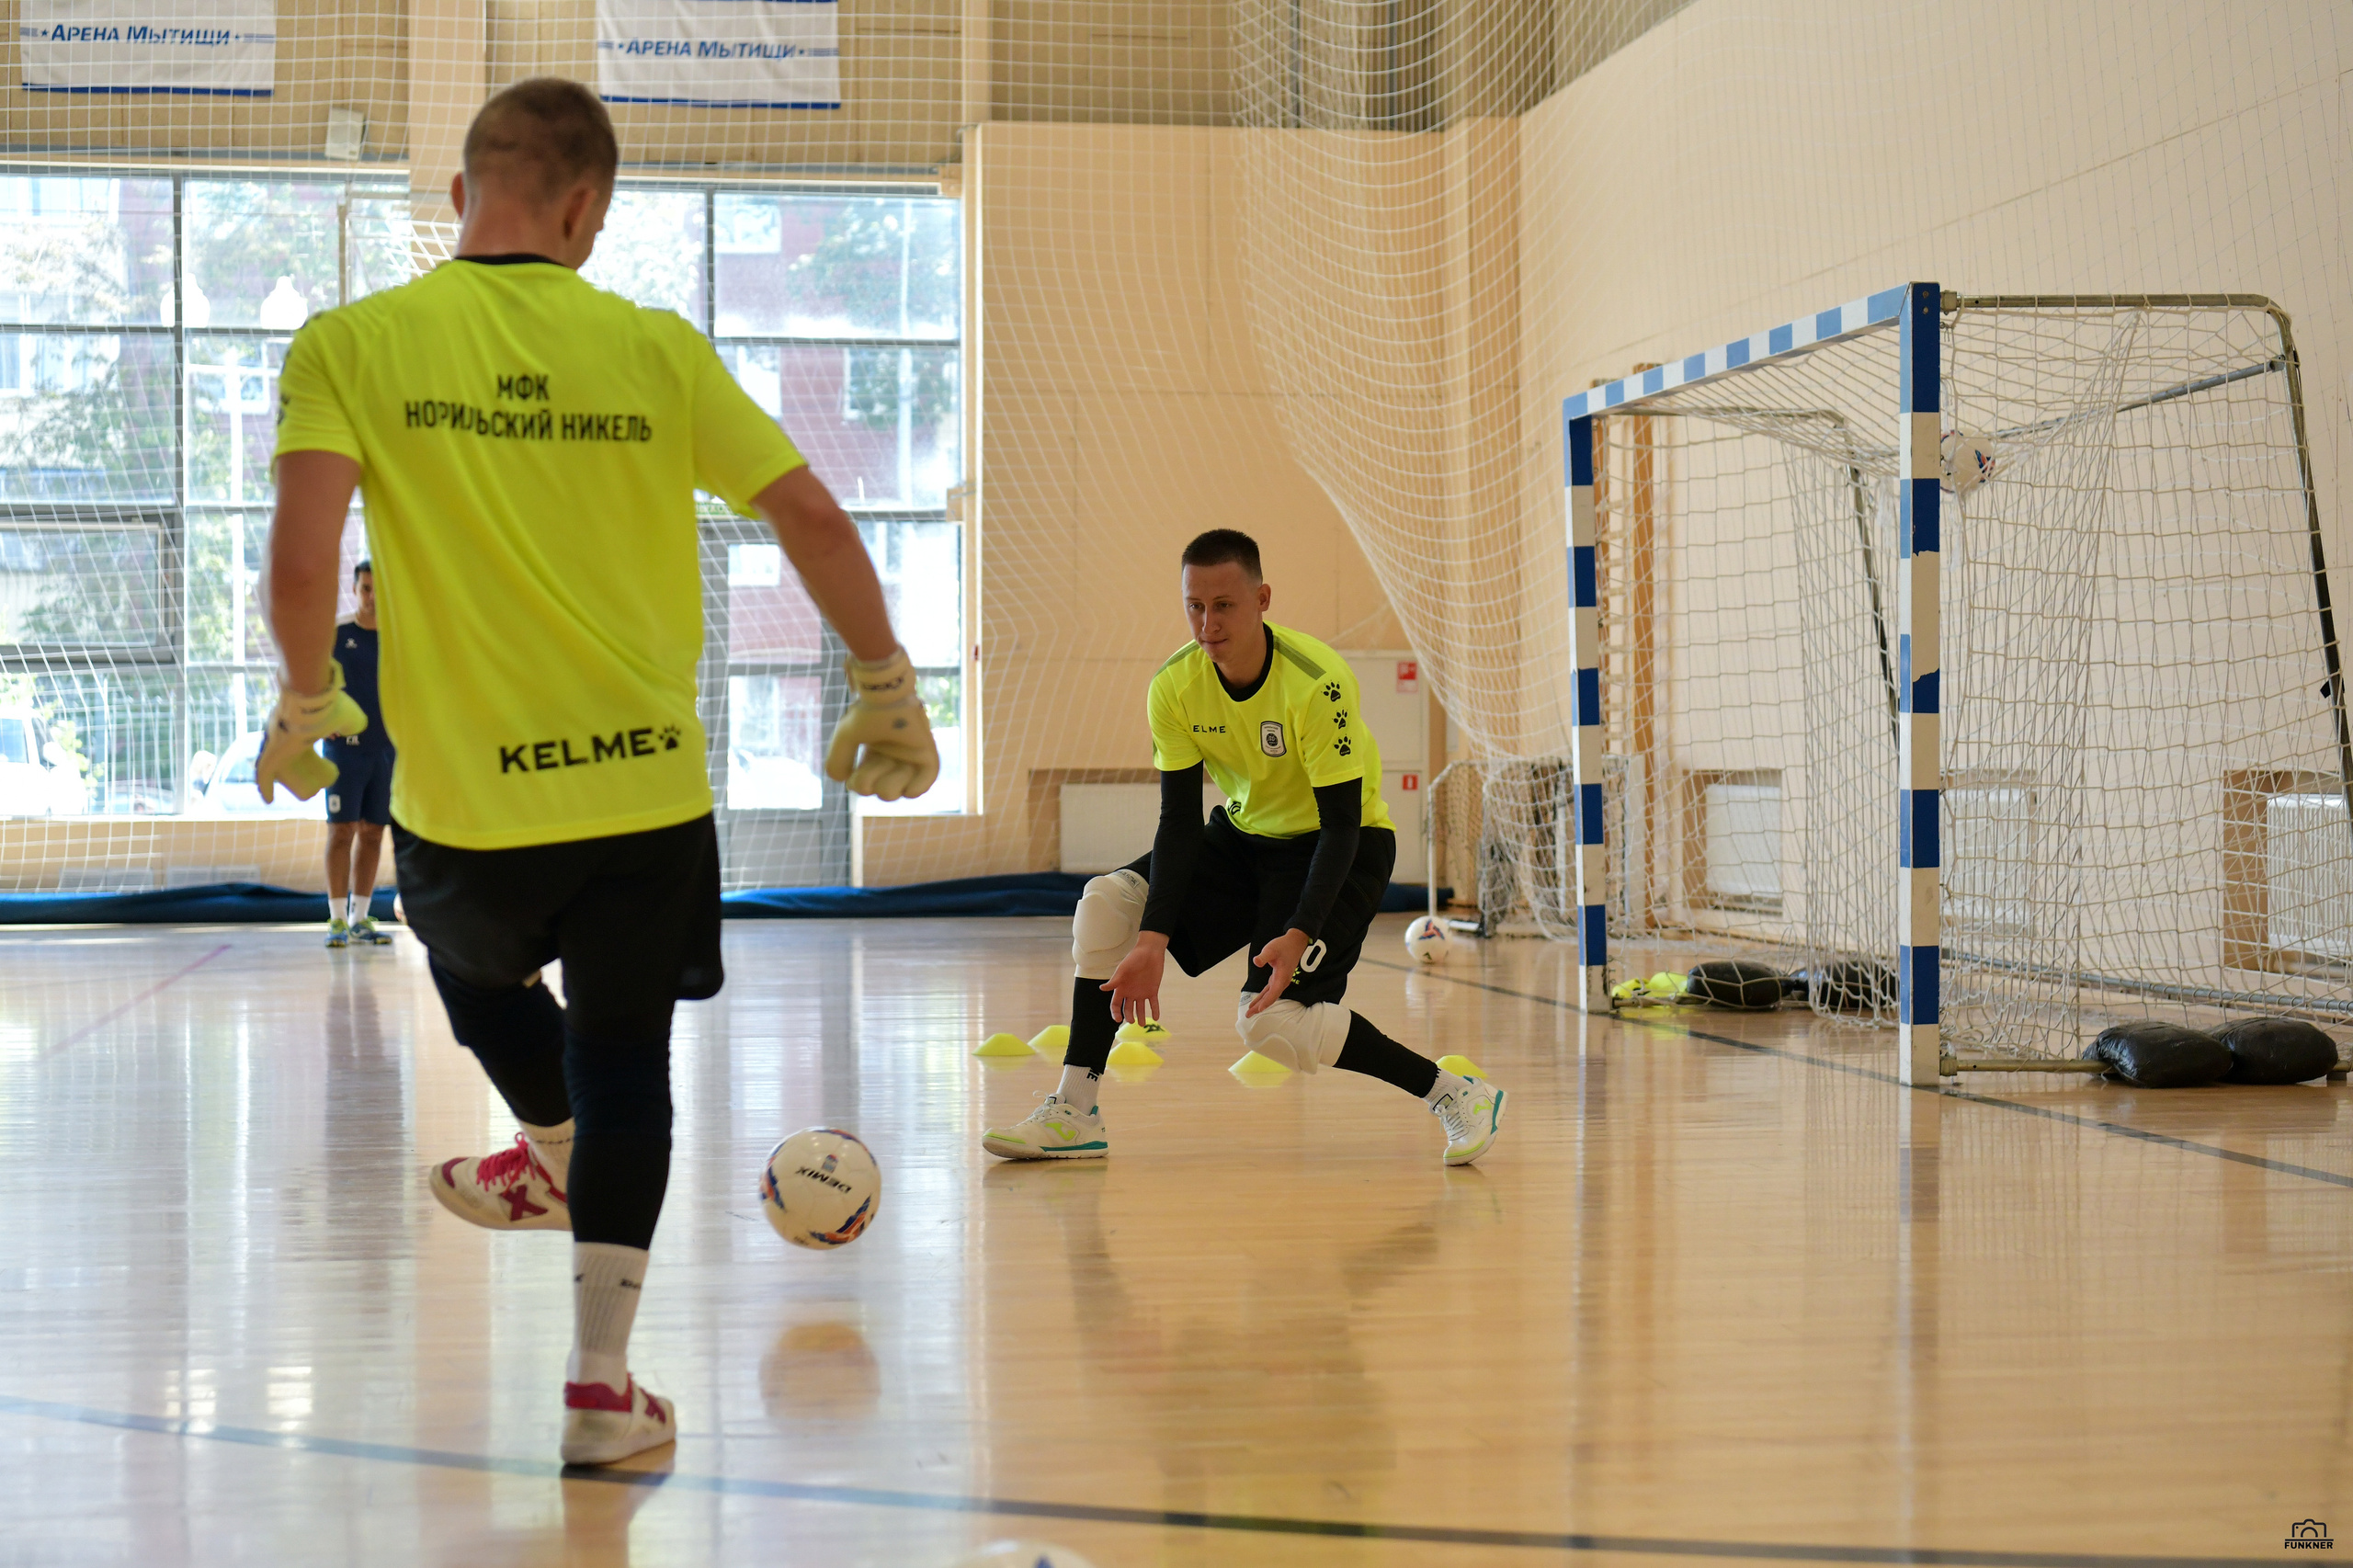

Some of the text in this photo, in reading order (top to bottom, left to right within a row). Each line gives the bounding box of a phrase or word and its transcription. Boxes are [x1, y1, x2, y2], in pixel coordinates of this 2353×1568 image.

[51, 24, 231, 47] АРЕНА МЫТИЩИ
[626, 37, 797, 62] АРЕНА МЫТИЩИ
[497, 374, 551, 401] МФК
[405, 401, 653, 442] НОРИЛЬСКИЙ НИКЕЛЬ
[1193, 724, 1226, 733] ELME
[499, 727, 656, 774] KELME
[795, 1165, 852, 1194] DEMIX
